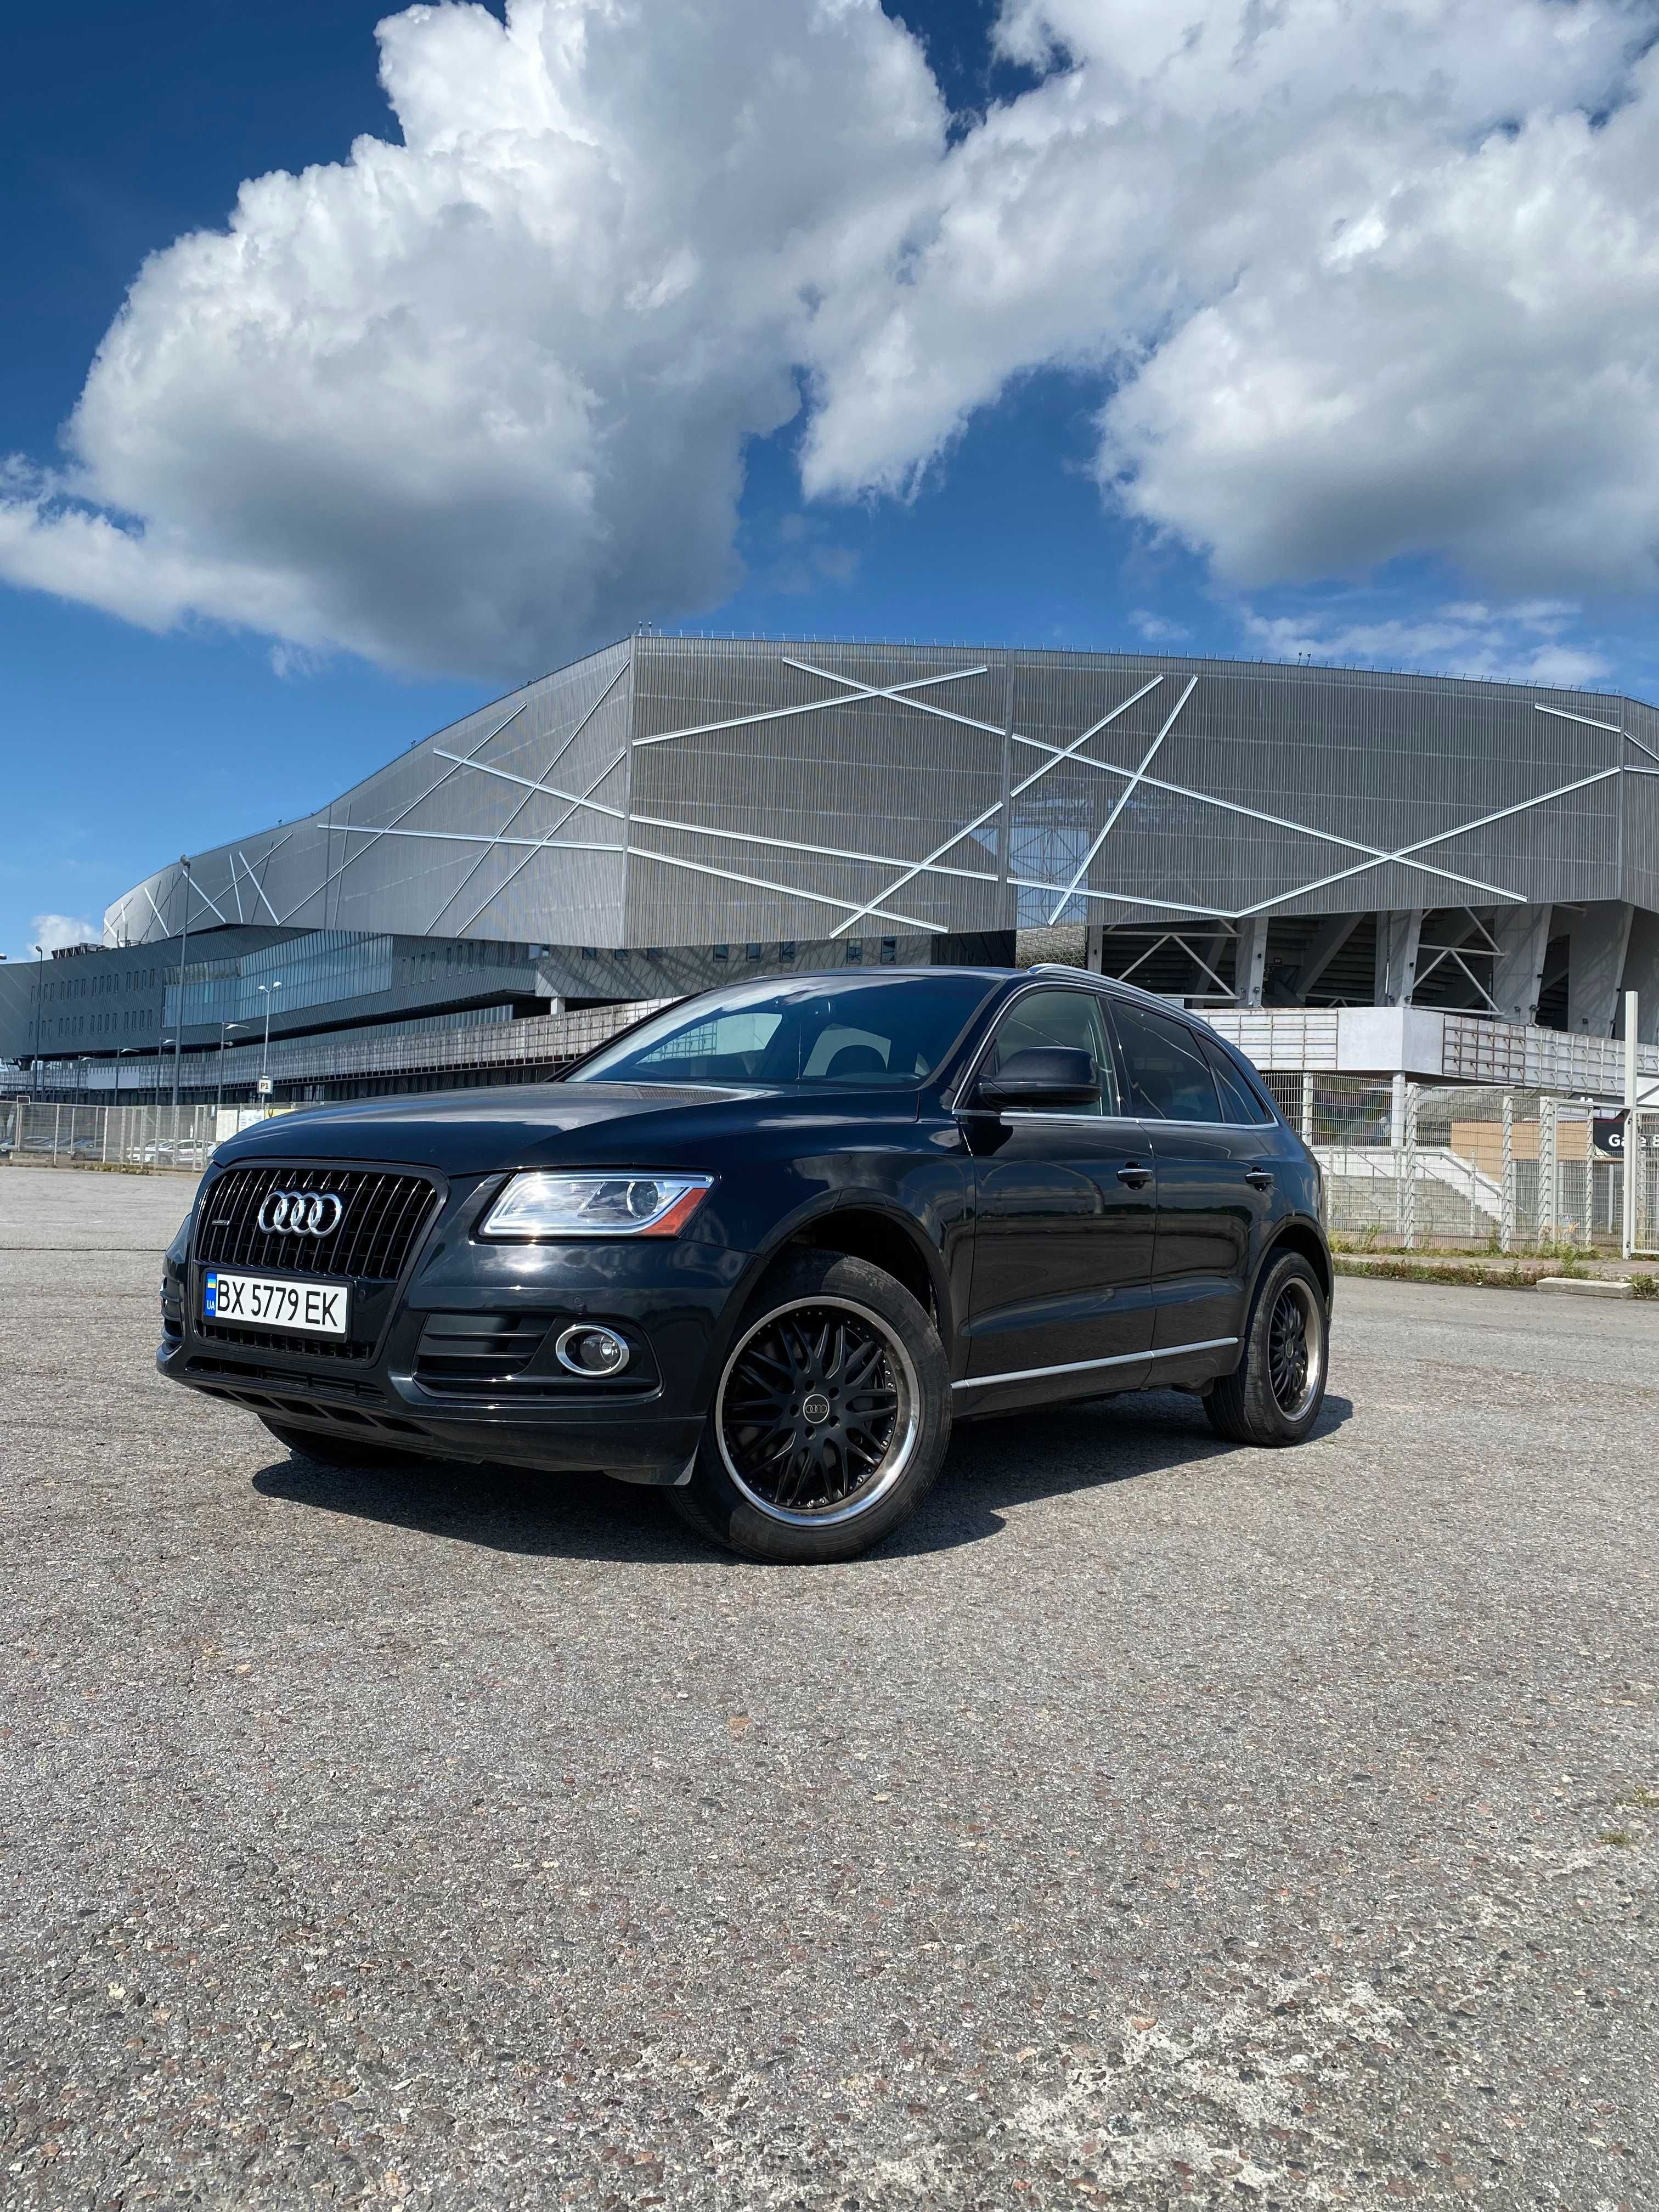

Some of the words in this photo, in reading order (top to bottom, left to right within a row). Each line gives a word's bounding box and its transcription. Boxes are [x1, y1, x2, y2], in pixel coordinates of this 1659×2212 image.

[207, 1300, 215, 1310] UA
[217, 1280, 245, 1314] BX
[251, 1284, 299, 1321] 5779
[305, 1290, 339, 1327] EK
